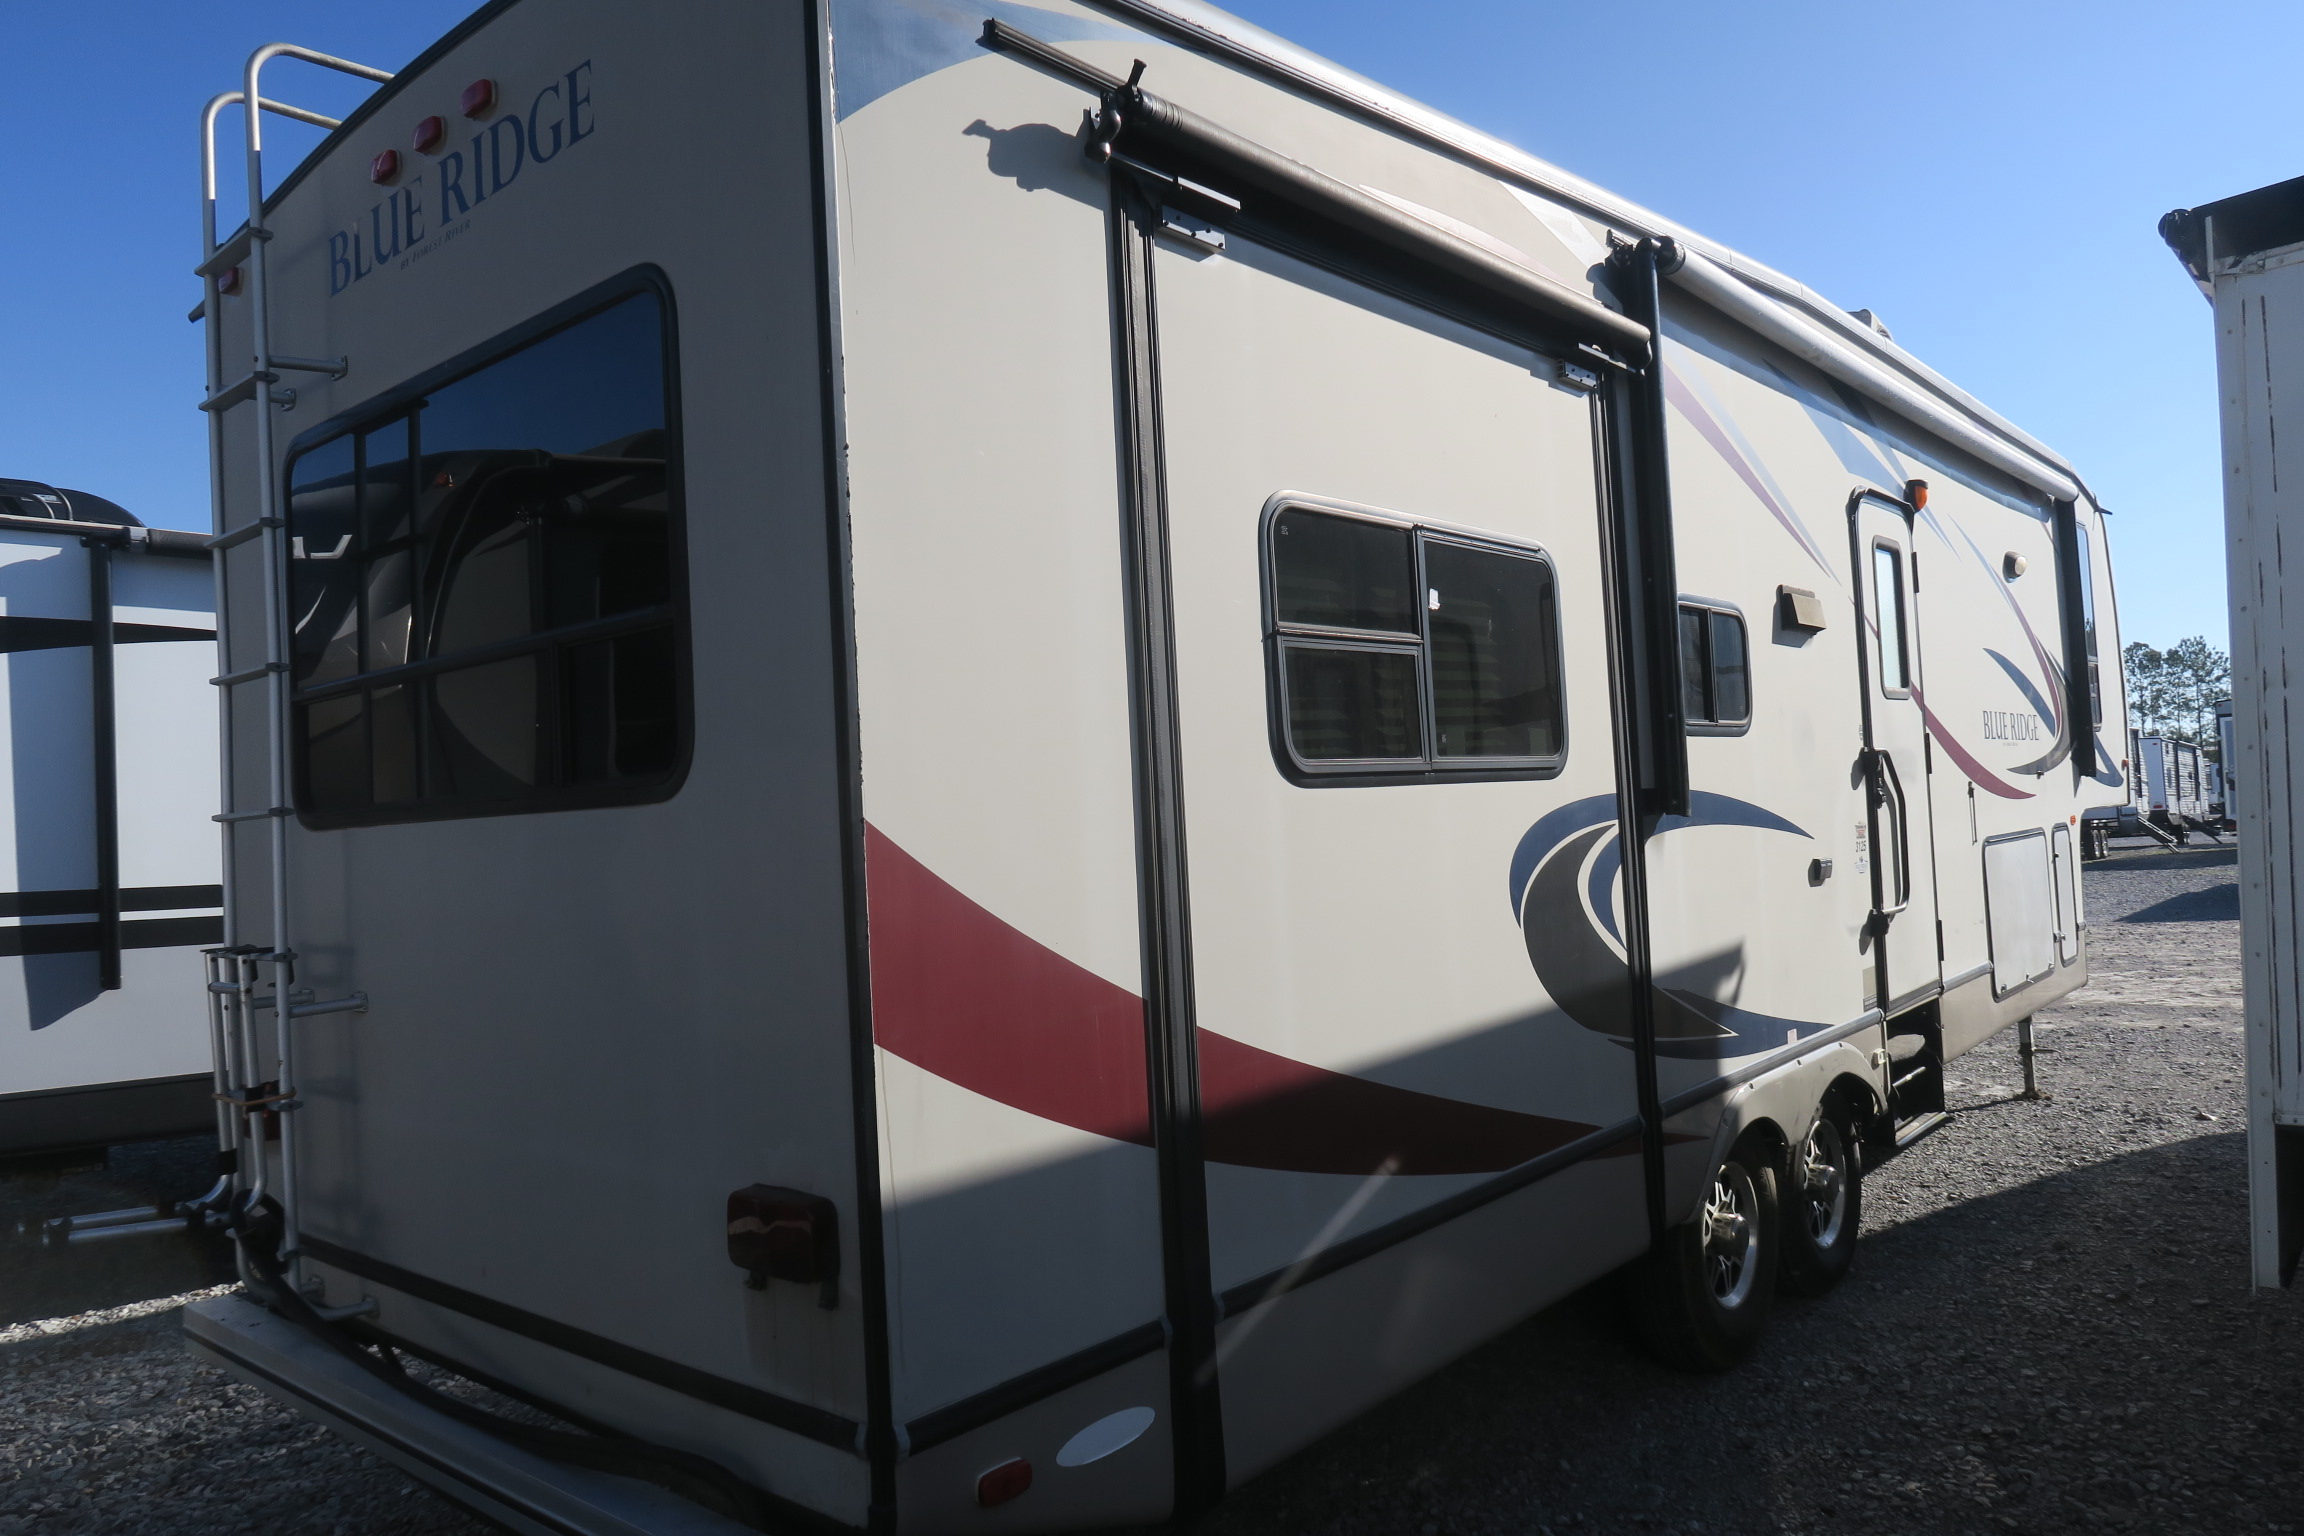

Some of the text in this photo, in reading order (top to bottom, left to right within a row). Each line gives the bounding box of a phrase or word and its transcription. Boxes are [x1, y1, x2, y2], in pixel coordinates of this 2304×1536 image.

[328, 58, 595, 298] BLUE RIDGE
[1982, 710, 2039, 741] BLUE RIDGE
